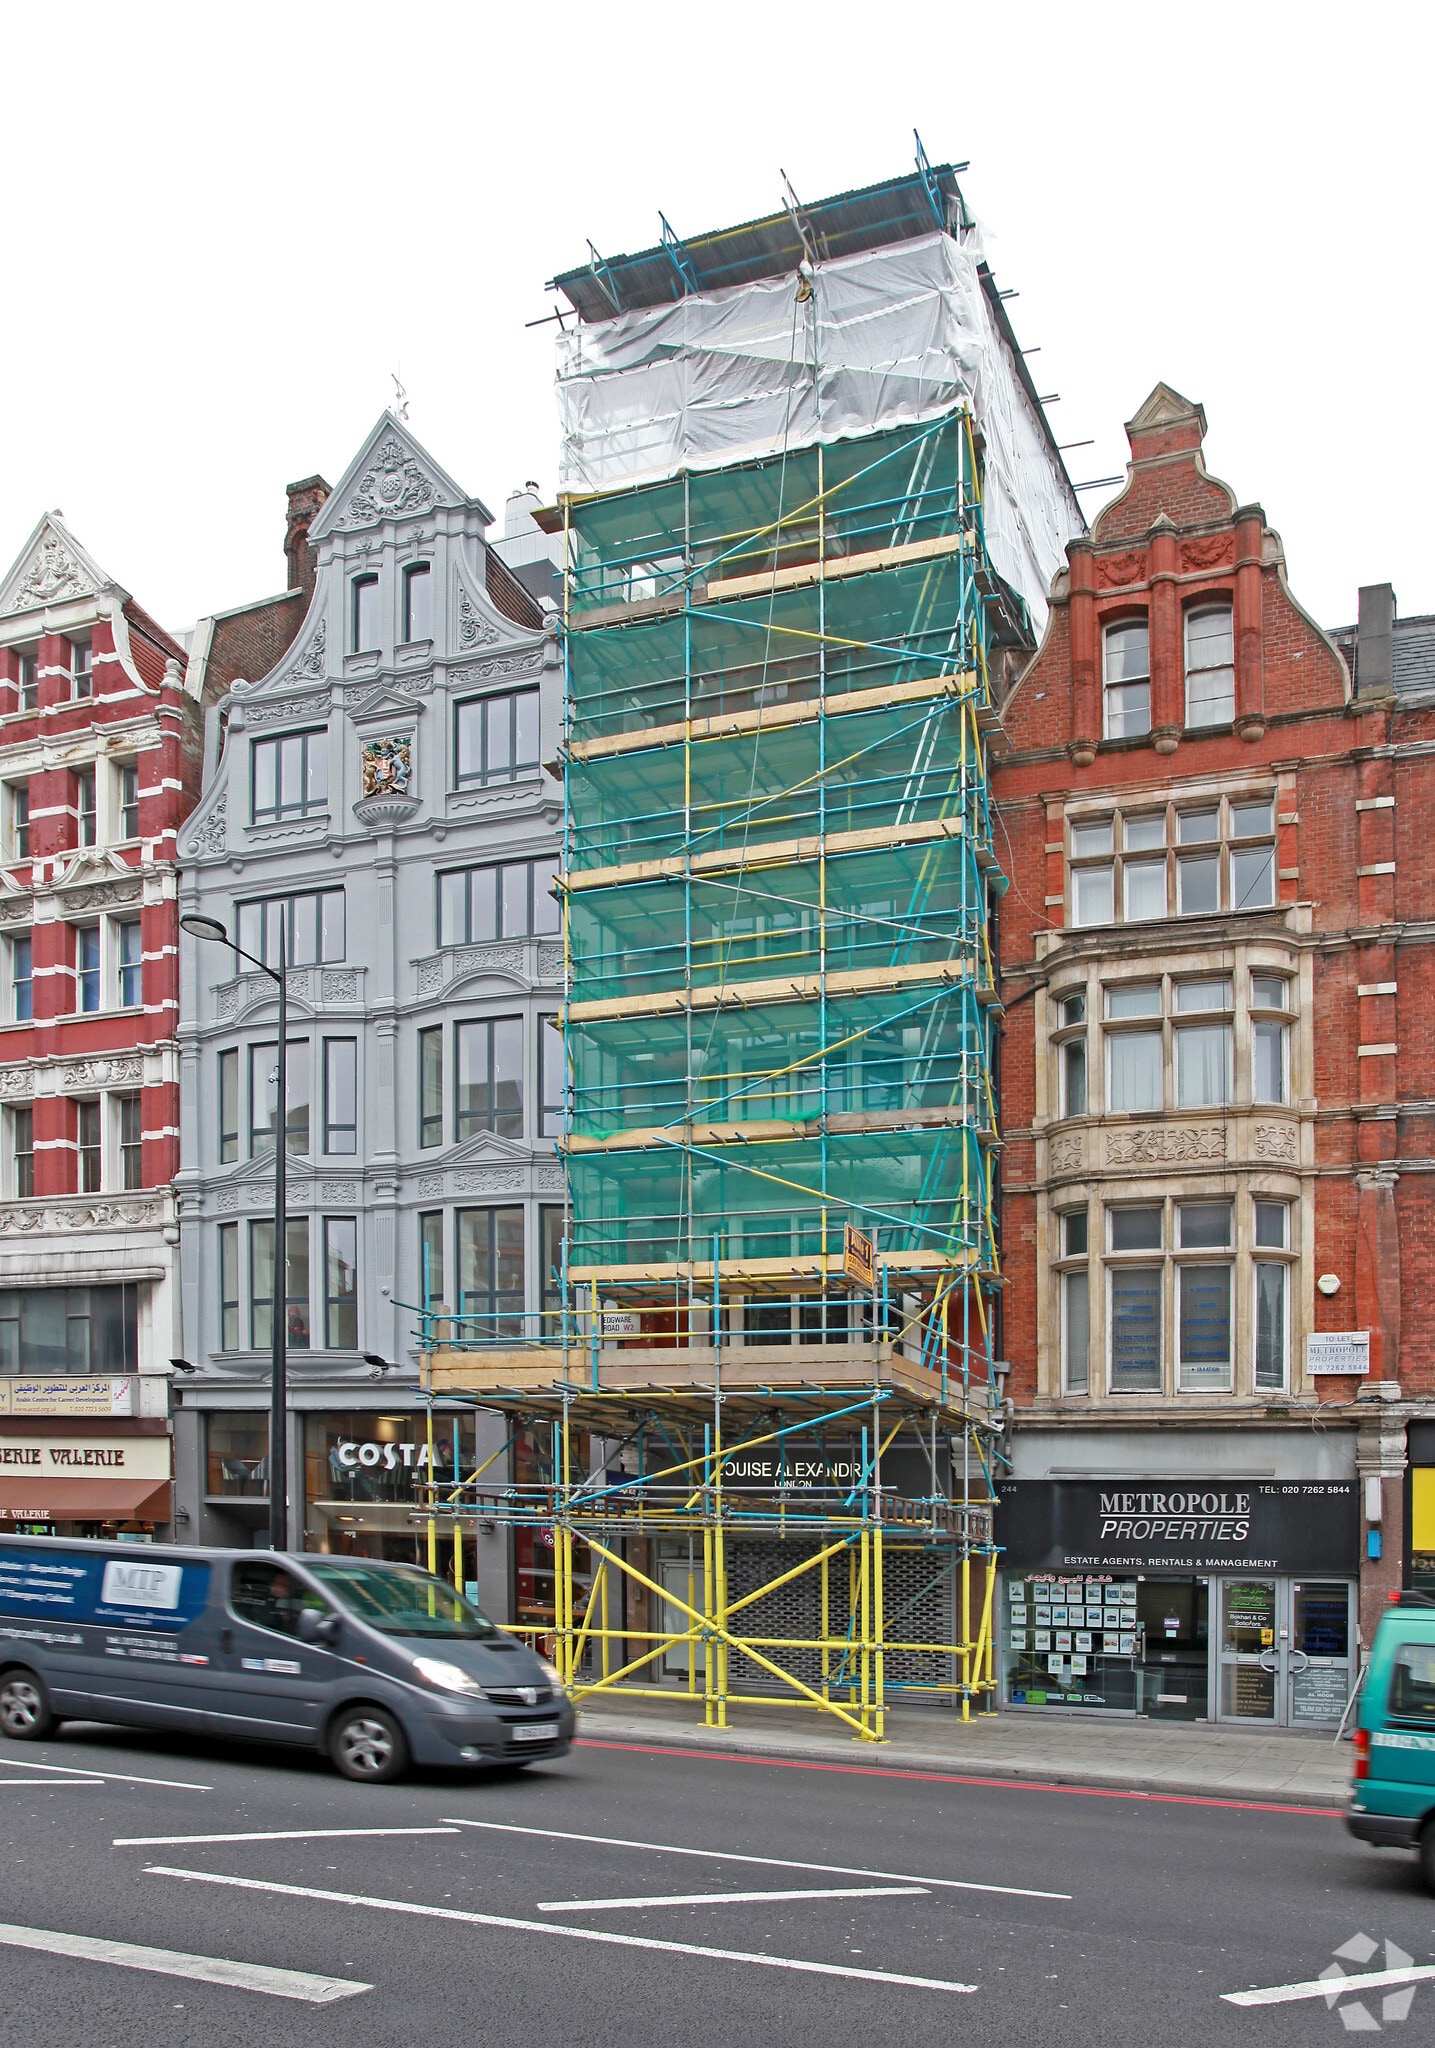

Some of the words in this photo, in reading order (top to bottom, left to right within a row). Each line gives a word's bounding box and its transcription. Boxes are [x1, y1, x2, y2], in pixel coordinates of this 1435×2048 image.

[603, 1316, 632, 1324] EDGWARE
[1309, 1346, 1367, 1354] METROPOLE
[0, 1448, 41, 1465] ERIE
[49, 1448, 124, 1467] VALERIE
[339, 1442, 441, 1469] COSTA
[1259, 1486, 1280, 1494] TEL:
[1283, 1486, 1299, 1494] 020
[1303, 1486, 1325, 1494] 7262
[1328, 1486, 1350, 1494] 5844
[1099, 1493, 1250, 1514] METROPOLE
[11, 1509, 50, 1519] VALERIE
[1100, 1520, 1249, 1541] PROPERTIES
[1064, 1556, 1099, 1565] ESTATE
[1148, 1558, 1192, 1567] RENTALS
[1195, 1559, 1203, 1567] &
[1205, 1559, 1278, 1568] MANAGEMENT
